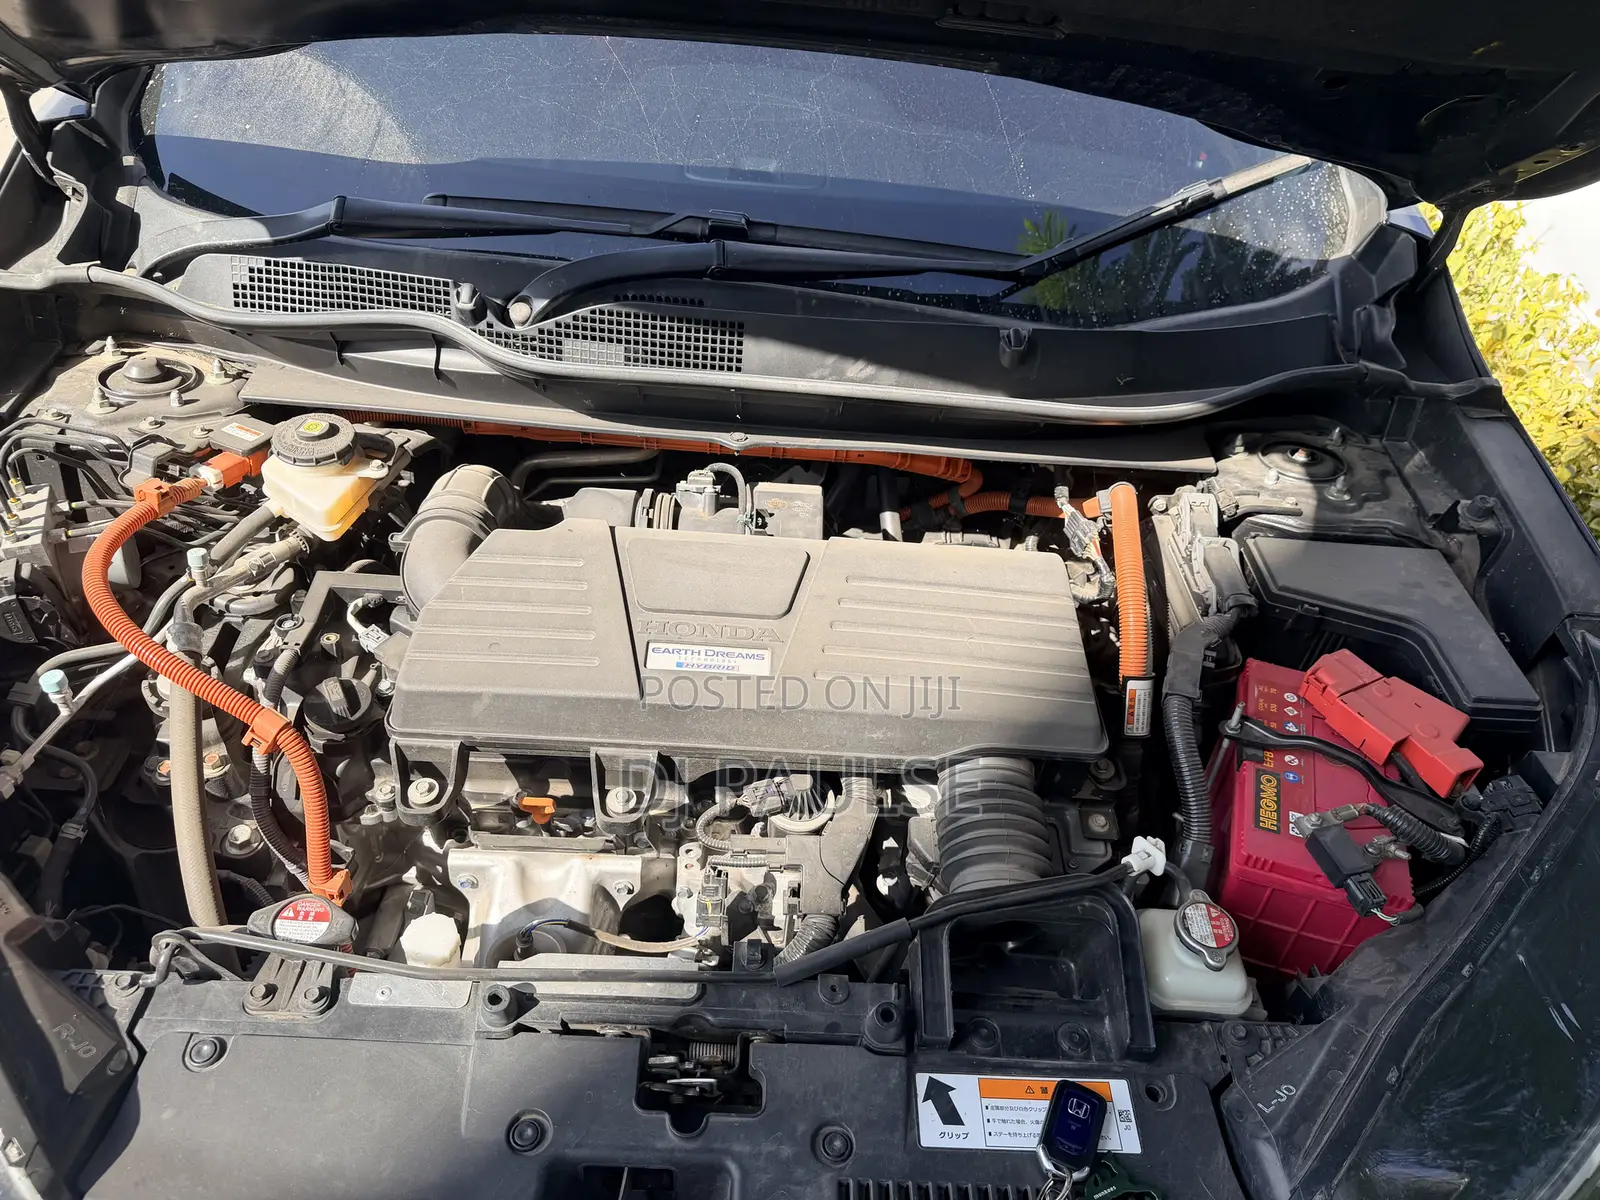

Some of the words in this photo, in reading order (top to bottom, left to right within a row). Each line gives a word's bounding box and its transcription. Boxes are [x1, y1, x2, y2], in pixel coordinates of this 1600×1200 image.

[637, 620, 784, 643] HONDA
[651, 646, 701, 657] EARTH
[704, 648, 765, 661] DREAMS
[684, 662, 735, 671] HYBRID
[1263, 751, 1274, 768] EFB
[1260, 774, 1277, 830] HEGMO
[938, 1131, 970, 1140] グリップ
